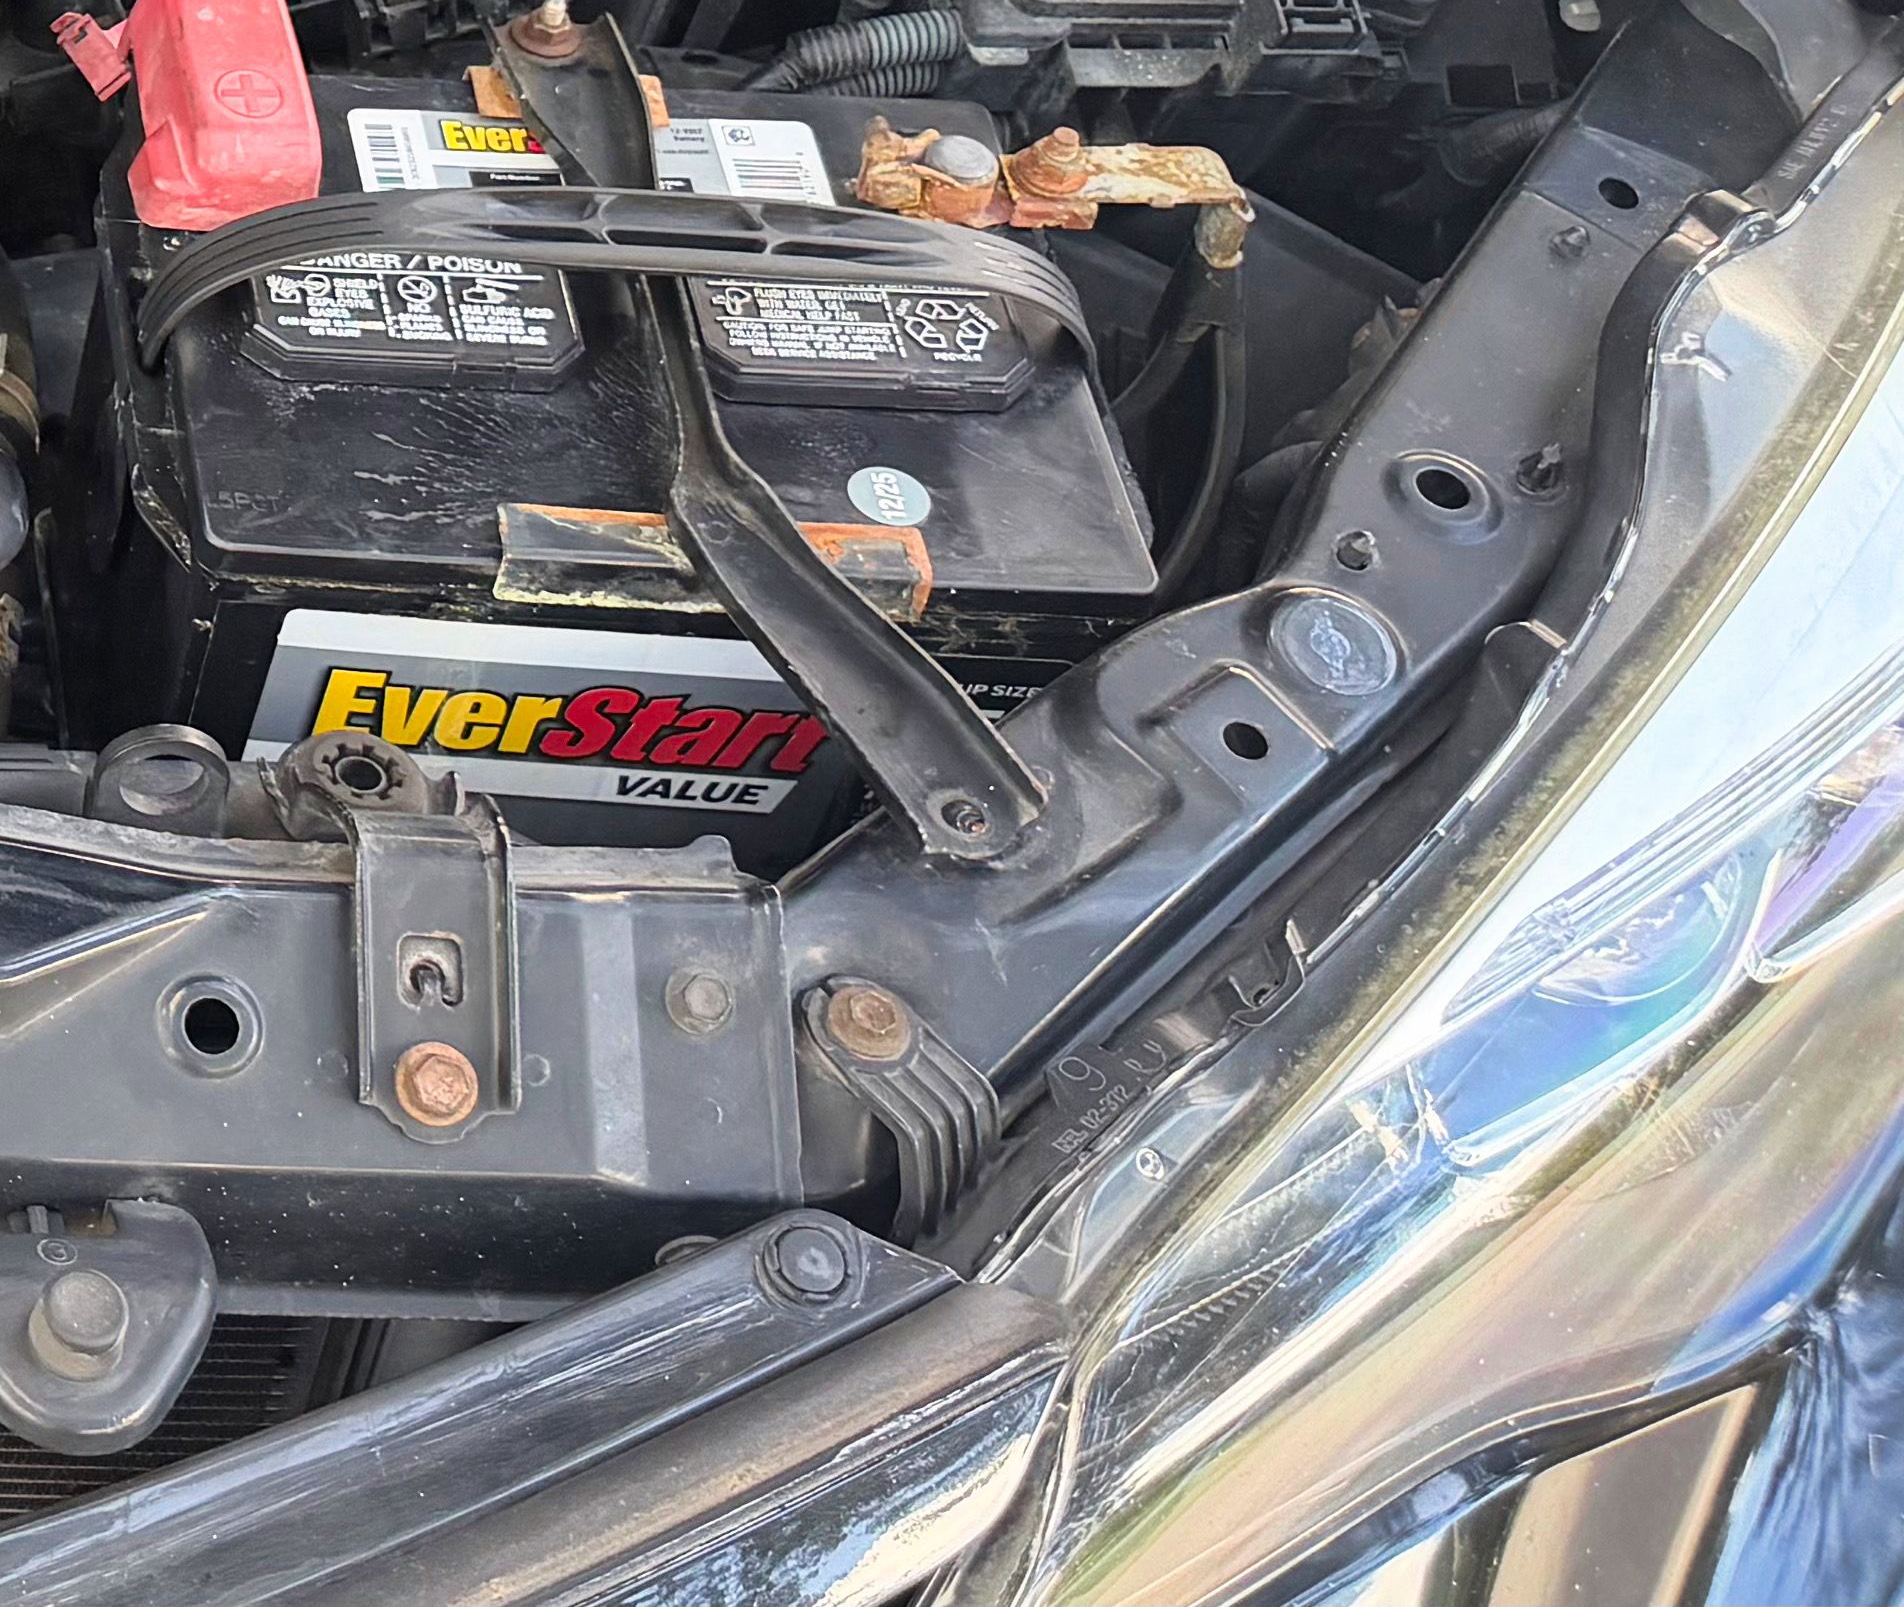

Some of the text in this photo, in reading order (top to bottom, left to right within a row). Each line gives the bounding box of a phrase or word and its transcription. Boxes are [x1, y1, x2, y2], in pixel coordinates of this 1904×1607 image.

[440, 119, 545, 154] Ever
[300, 252, 402, 270] ANGER
[428, 255, 523, 274] POISON
[407, 302, 431, 314] NO
[459, 304, 521, 317] SULFURIC
[870, 472, 908, 520] 12/25
[309, 667, 833, 773] EverStart
[614, 773, 771, 806] VALUE
